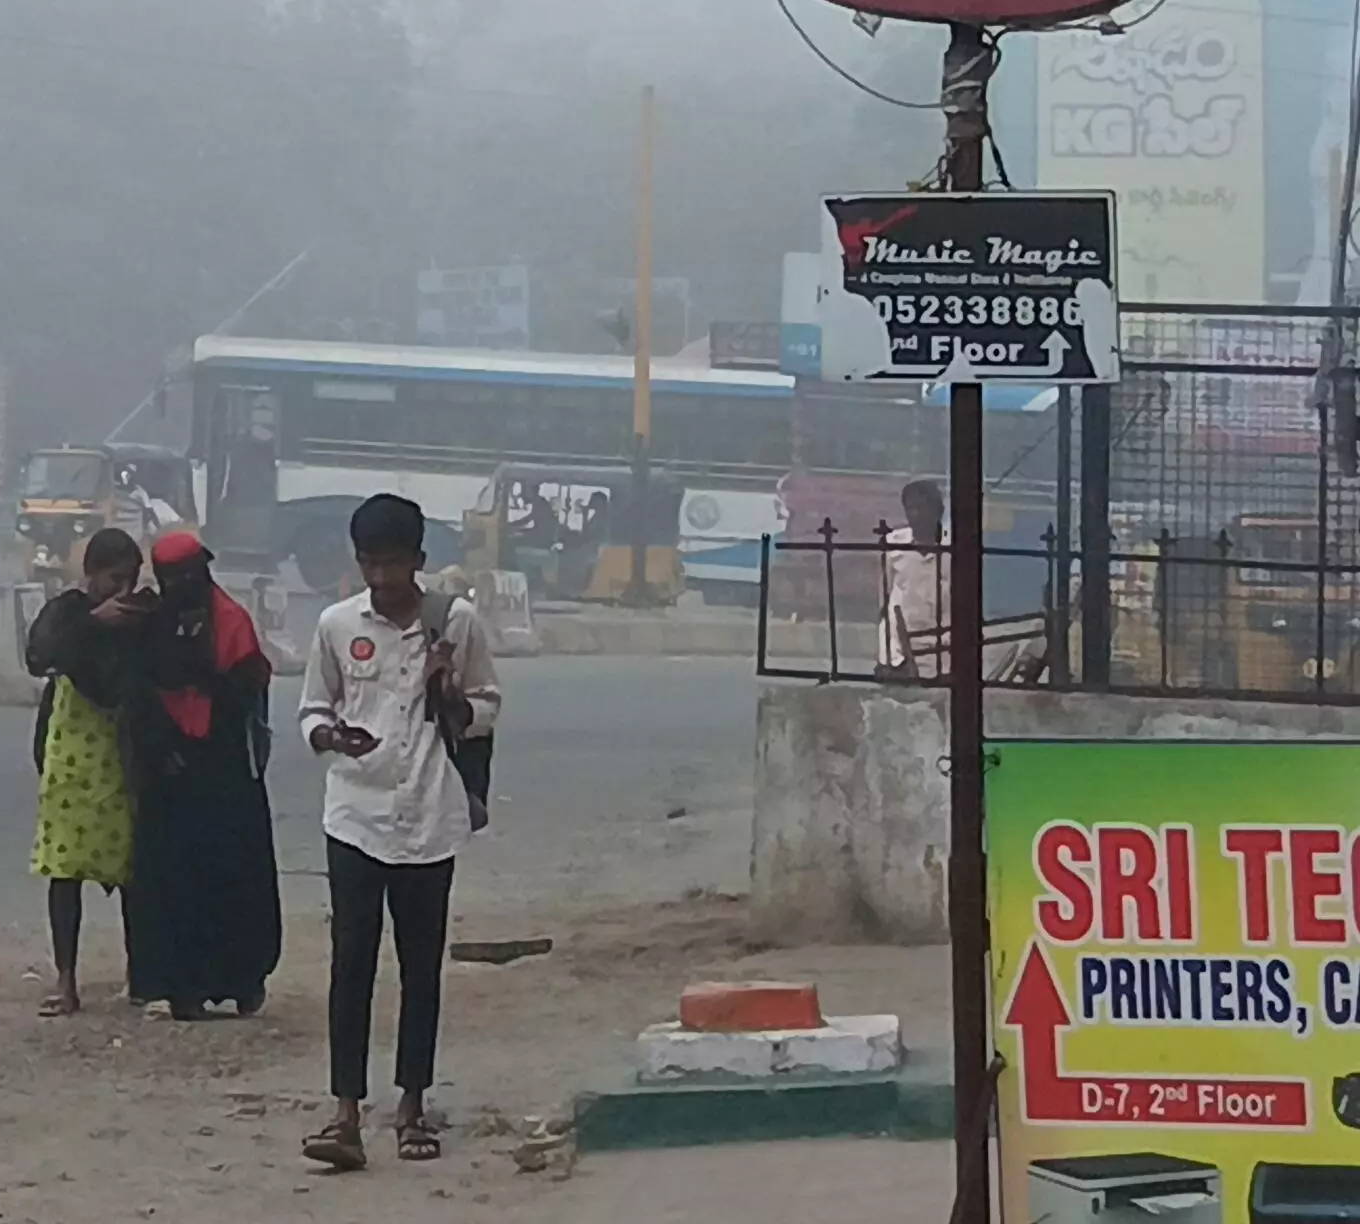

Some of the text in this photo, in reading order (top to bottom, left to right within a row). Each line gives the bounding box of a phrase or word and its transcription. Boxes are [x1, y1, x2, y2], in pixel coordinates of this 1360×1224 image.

[863, 235, 1102, 274] Music Magic
[930, 336, 1025, 362] Floor
[1037, 825, 1360, 942] SRI TE
[1081, 957, 1360, 1034] PRINTERS, C
[1081, 1082, 1277, 1119] D-7, 2nd Floor
